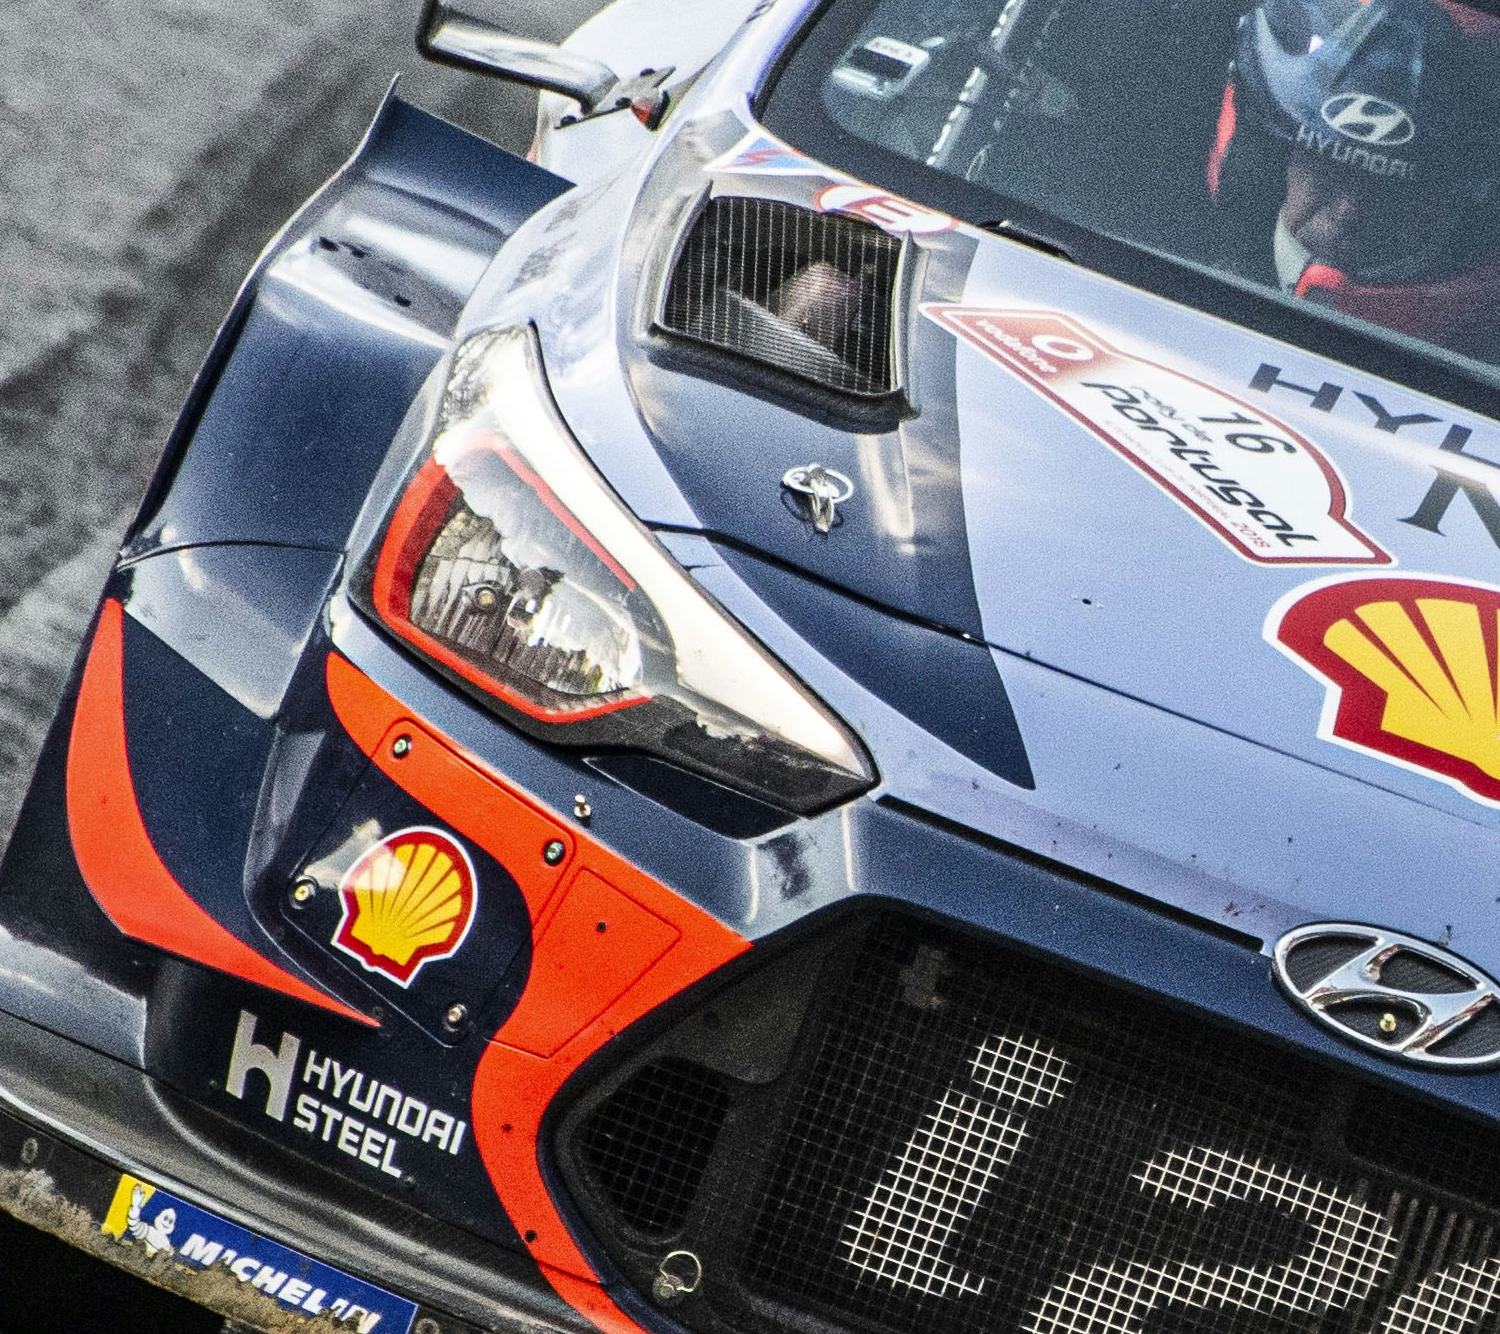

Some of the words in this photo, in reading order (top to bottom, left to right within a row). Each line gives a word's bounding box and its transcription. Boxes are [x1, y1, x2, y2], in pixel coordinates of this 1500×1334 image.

[1078, 381, 1318, 549] Portugal
[1200, 411, 1298, 455] 16
[295, 1097, 403, 1179] STEEL
[304, 1050, 467, 1156] HYUNDAI
